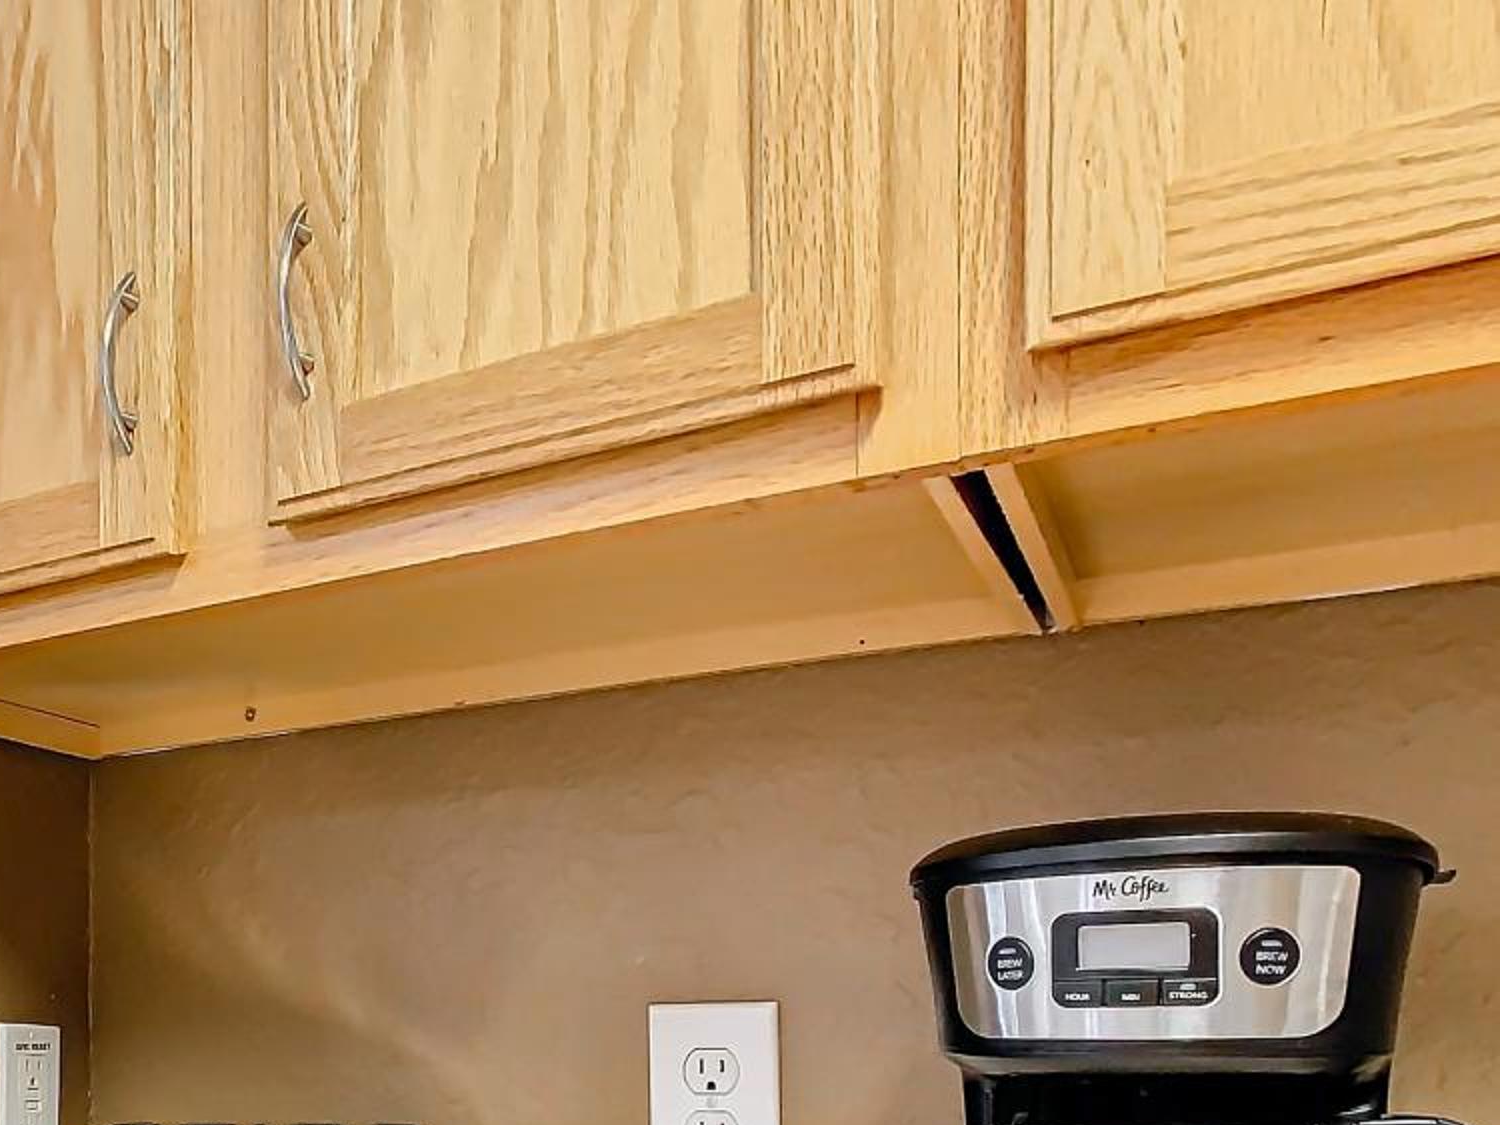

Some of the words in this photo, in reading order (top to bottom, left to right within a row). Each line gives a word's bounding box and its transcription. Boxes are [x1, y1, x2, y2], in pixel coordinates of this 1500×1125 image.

[1121, 876, 1170, 902] Coffee
[1255, 951, 1288, 962] BREW
[997, 958, 1023, 970] BREW
[1255, 964, 1287, 976] NOW
[1168, 991, 1209, 1000] STRONG
